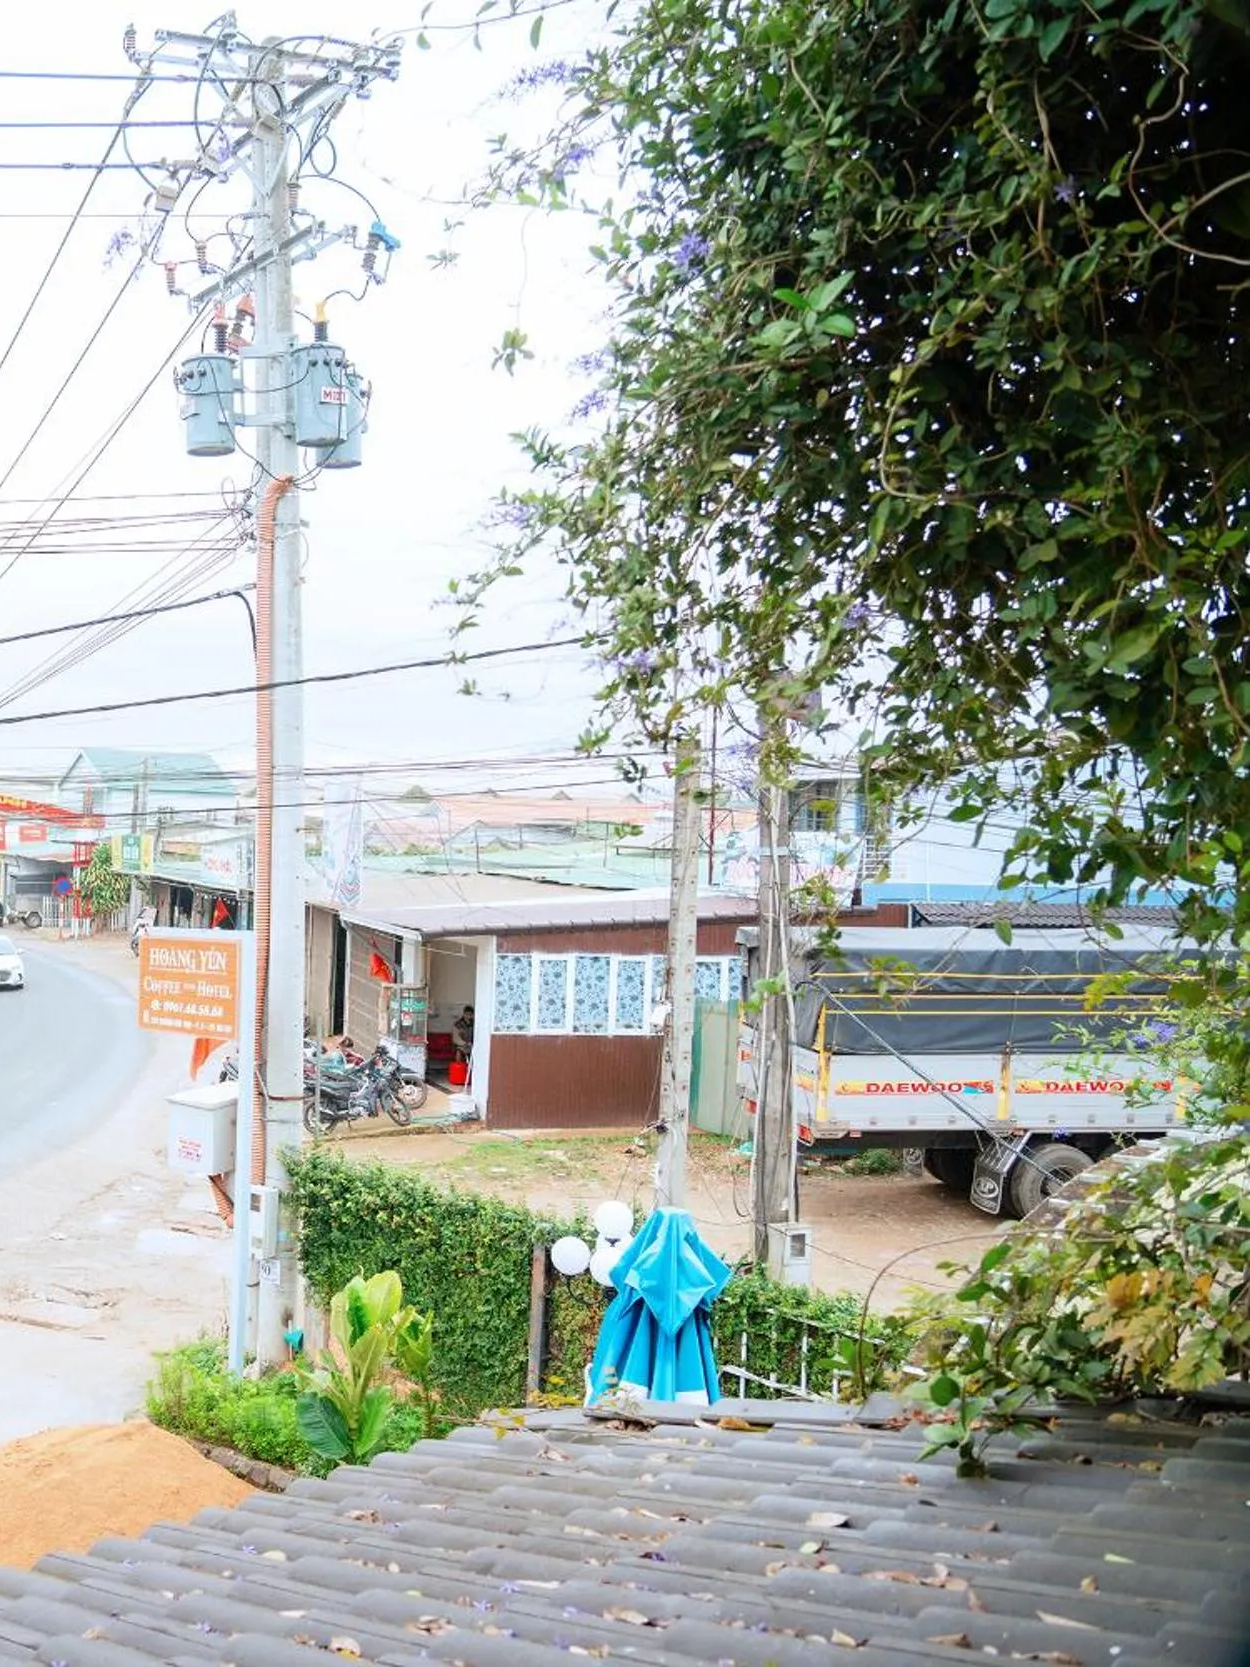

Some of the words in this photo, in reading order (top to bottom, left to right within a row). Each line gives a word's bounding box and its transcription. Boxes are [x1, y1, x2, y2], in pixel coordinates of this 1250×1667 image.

[149, 945, 196, 971] HOÀNG
[865, 1082, 963, 1094] DAEWOO
[1044, 1080, 1125, 1094] DAEWO
